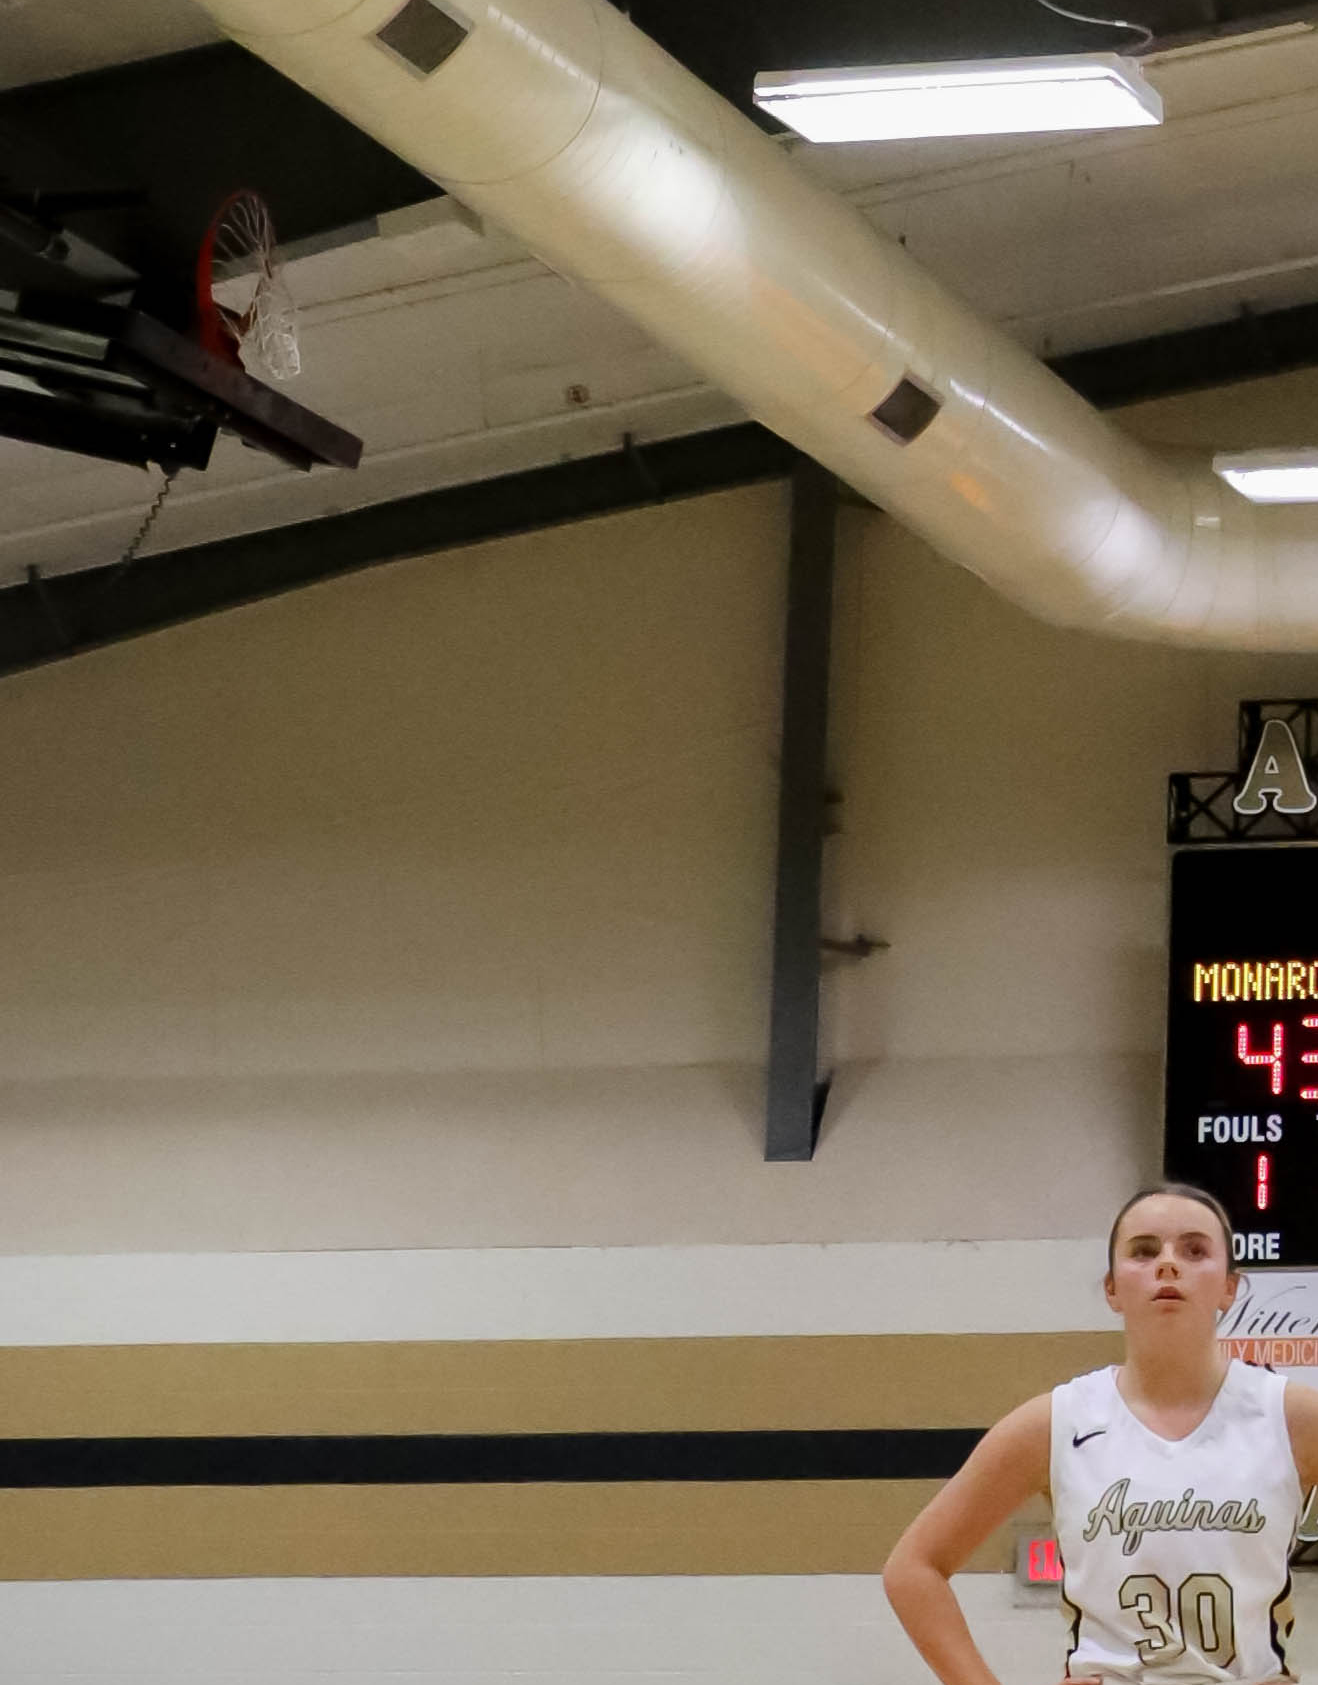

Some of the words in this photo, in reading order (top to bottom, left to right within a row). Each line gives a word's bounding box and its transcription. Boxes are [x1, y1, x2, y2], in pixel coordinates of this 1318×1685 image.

[1197, 1115, 1283, 1143] FOULS
[1257, 1155, 1269, 1210] 1
[1231, 1232, 1281, 1261] ORE
[1083, 1478, 1266, 1556] Aquinas
[1119, 1573, 1236, 1668] 30
